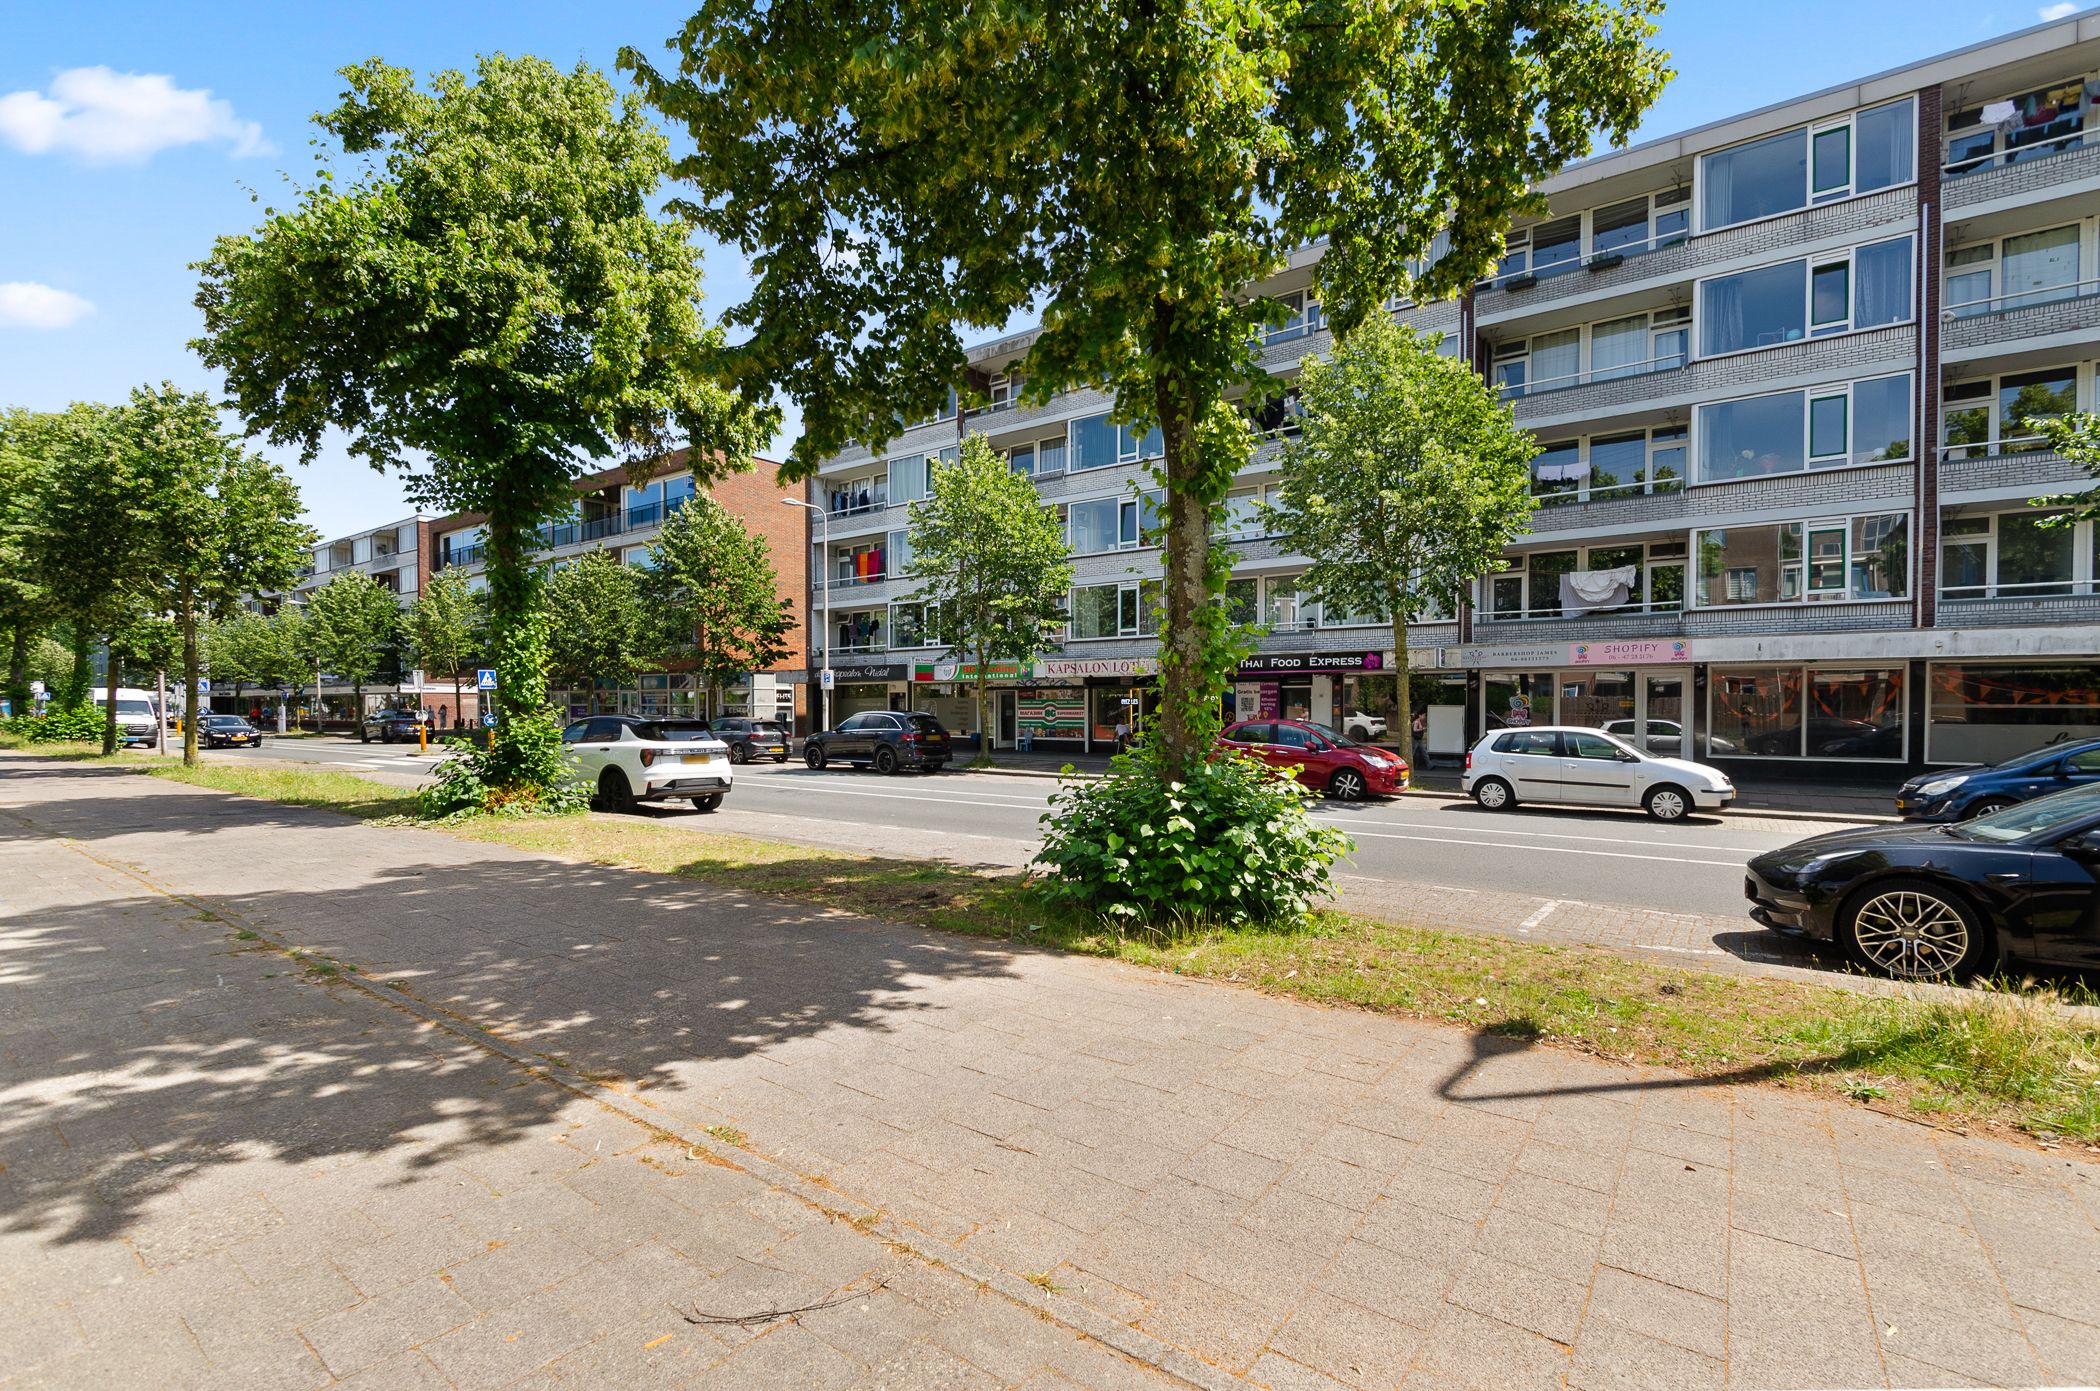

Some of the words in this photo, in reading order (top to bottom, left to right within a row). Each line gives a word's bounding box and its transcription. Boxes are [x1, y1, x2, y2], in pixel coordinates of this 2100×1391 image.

[1604, 644, 1658, 653] SHOPIFY
[1240, 658, 1263, 668] THAI
[1271, 658, 1301, 668] FOOD
[1309, 656, 1363, 667] EXPRESS
[864, 665, 890, 677] Nidal
[962, 665, 976, 673] BG
[1047, 661, 1109, 674] KAPSALON
[1045, 709, 1056, 717] BG
